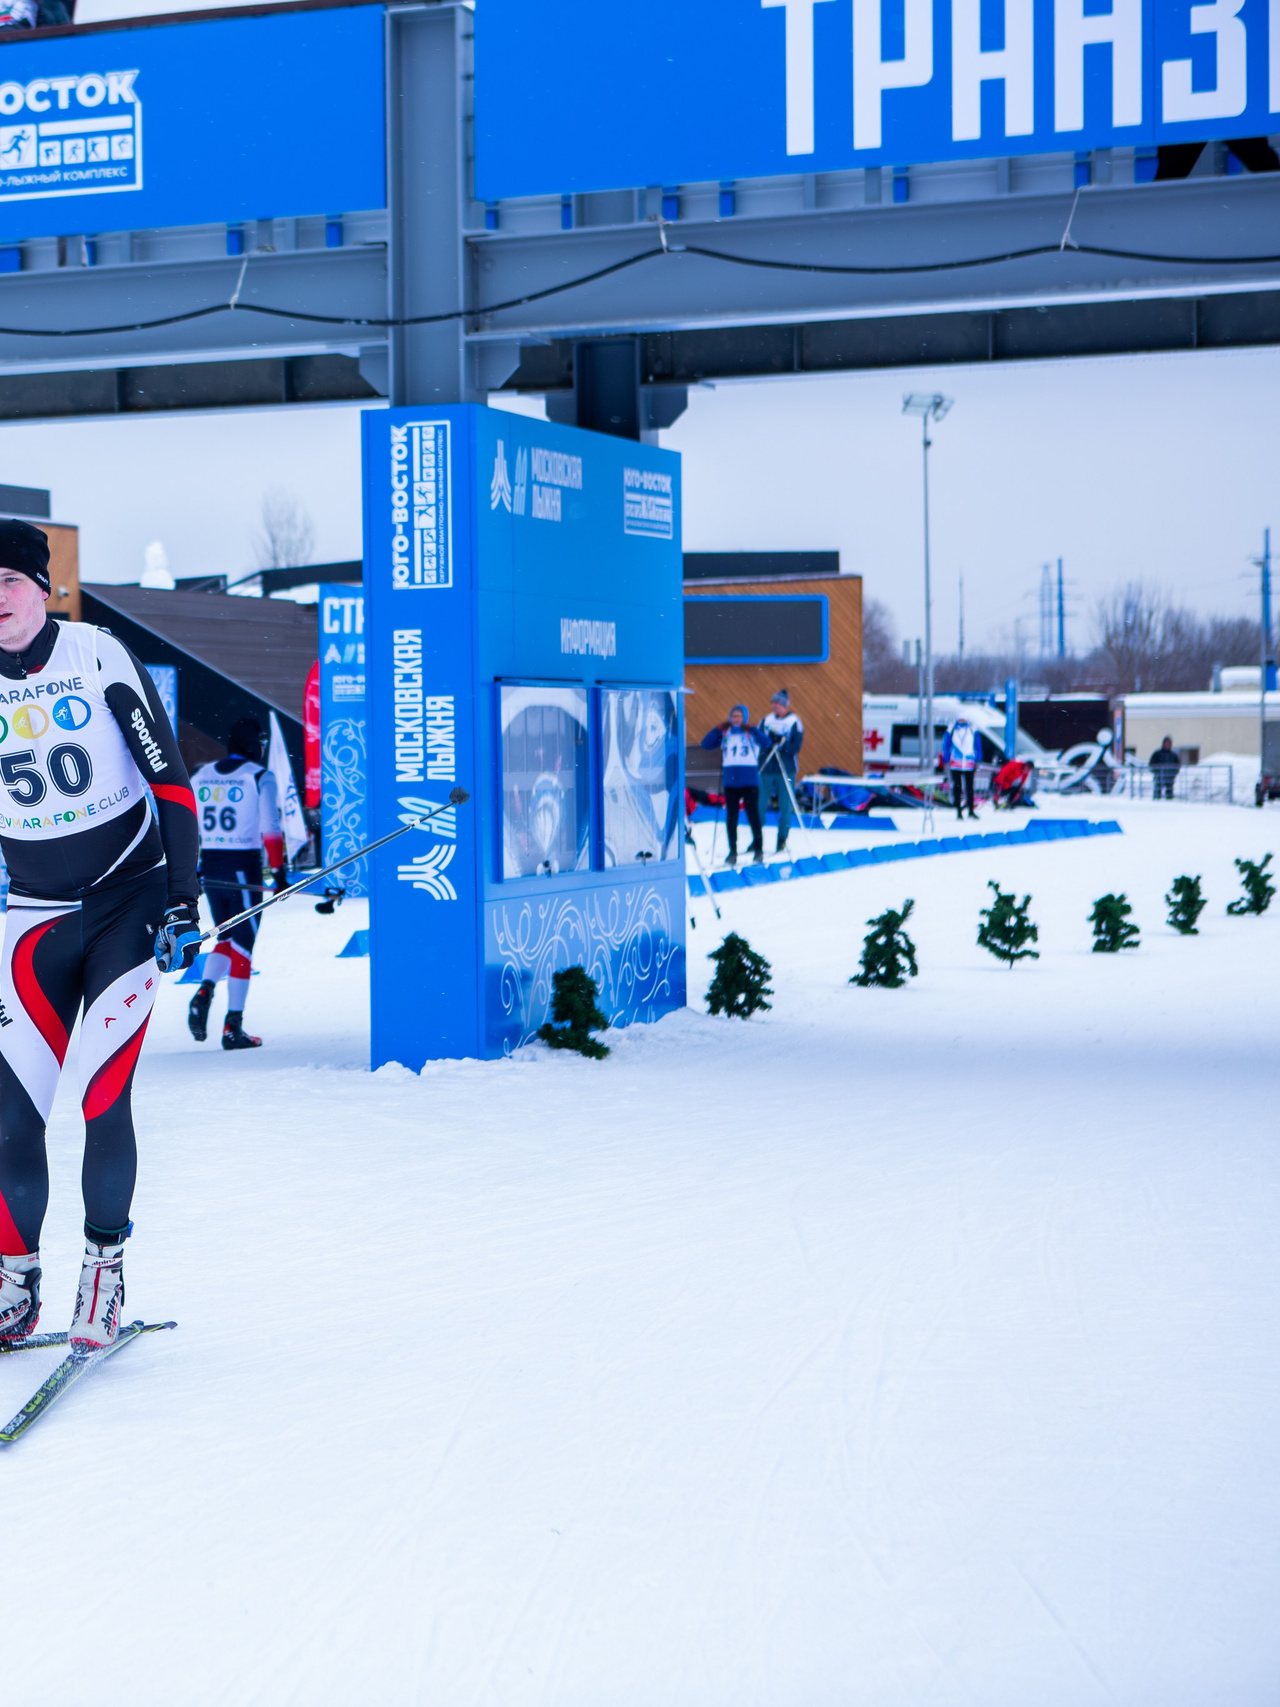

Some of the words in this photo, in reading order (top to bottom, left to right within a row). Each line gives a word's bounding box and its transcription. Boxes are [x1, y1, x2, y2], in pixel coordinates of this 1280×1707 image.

[761, 0, 1280, 156] ТРАНЗ
[63, 166, 128, 183] КОМПЛЕКС
[531, 446, 583, 490] МОСКОВСКАЯ
[623, 467, 672, 493] ЮГО-ВОСТОК
[390, 424, 410, 591] ЮГО-ВОСТОК
[532, 484, 562, 522] ЛЫЖНЯ
[560, 618, 616, 660] ИНФОРМАЦИЯ
[393, 629, 424, 782] МОСКОВСКАЯ
[131, 707, 168, 773] sportful
[425, 695, 456, 783] ЛЫЖНЯ
[203, 806, 238, 832] 56
